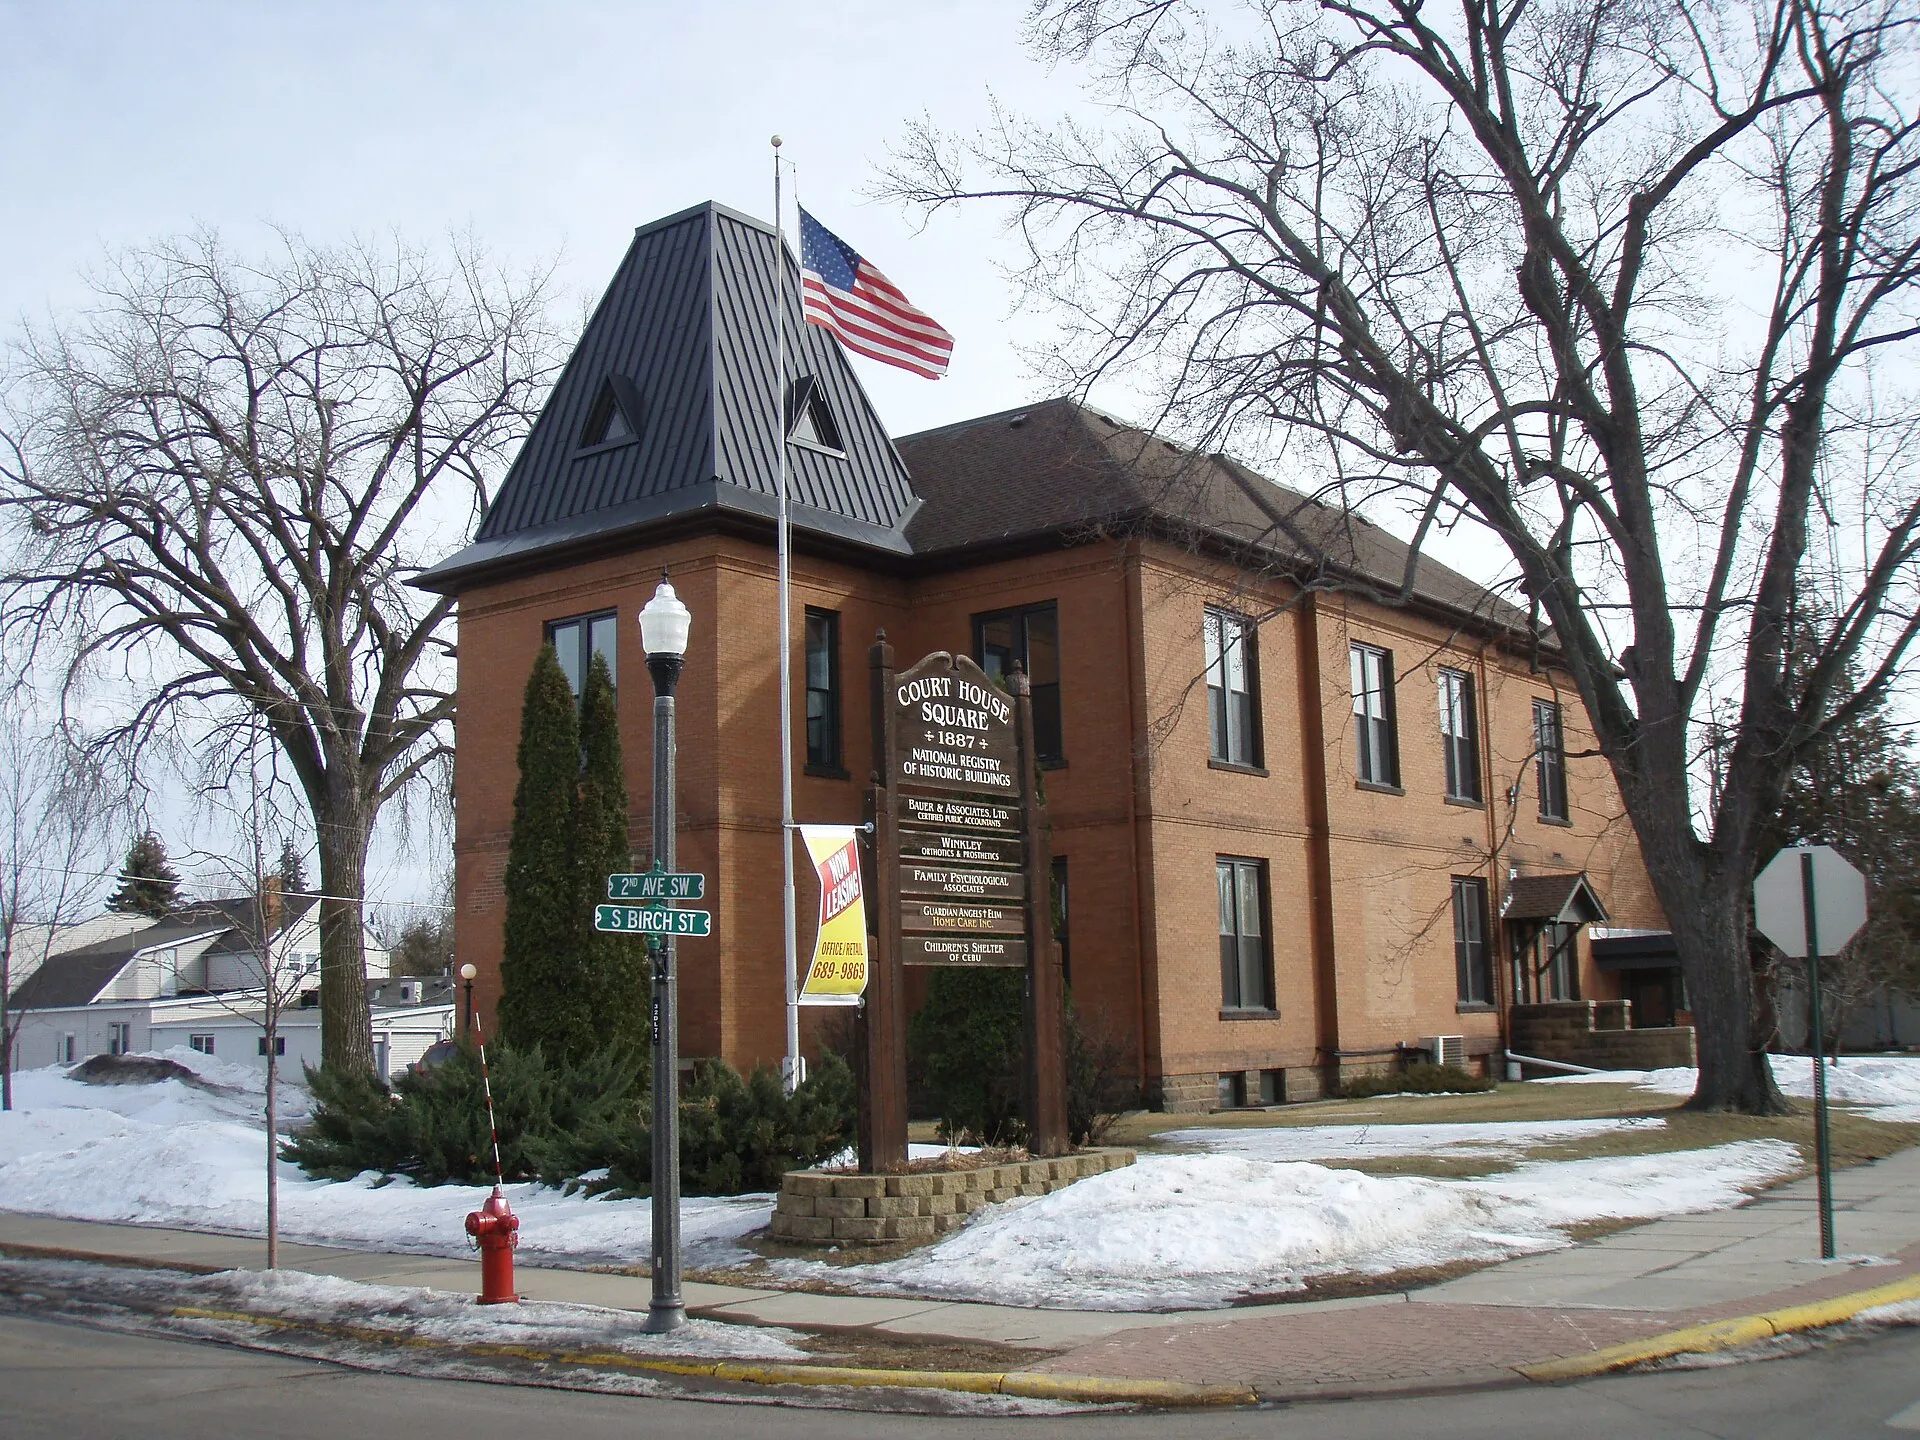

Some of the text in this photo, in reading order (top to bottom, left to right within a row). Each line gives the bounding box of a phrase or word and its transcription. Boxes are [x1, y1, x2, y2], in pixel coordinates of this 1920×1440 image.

[897, 677, 1010, 725] COURT HOUSE
[922, 702, 989, 730] SQUARE
[938, 731, 975, 748] 1887
[912, 748, 1000, 771] NATIONAL REGISTRY
[904, 762, 1010, 786] OF HISTORIC BUILDINGS
[909, 799, 934, 812] BAUER
[937, 804, 943, 812] &
[993, 809, 1009, 820] LTD.
[918, 812, 1001, 828] CERTIFIED PUBLIC ACCOUNTANTS
[941, 837, 982, 850] WINKLEY
[921, 848, 954, 857] ORTHOTICS
[963, 851, 999, 860] PROSTHETICS
[829, 848, 850, 885] NOW
[642, 878, 665, 896] AVE
[671, 878, 690, 896] SW
[914, 870, 1008, 886] FAMILY PSYCHOLOGICAL
[826, 871, 859, 920] LEASING
[943, 884, 984, 893] ASSOCIATES
[612, 909, 696, 931] S BIRCH ST
[923, 906, 958, 916] GUARDIAN
[933, 916, 993, 928] HOME CARE INC.
[924, 941, 1004, 953] CHILDREN'S SHELTER
[813, 961, 864, 980] 689-9869
